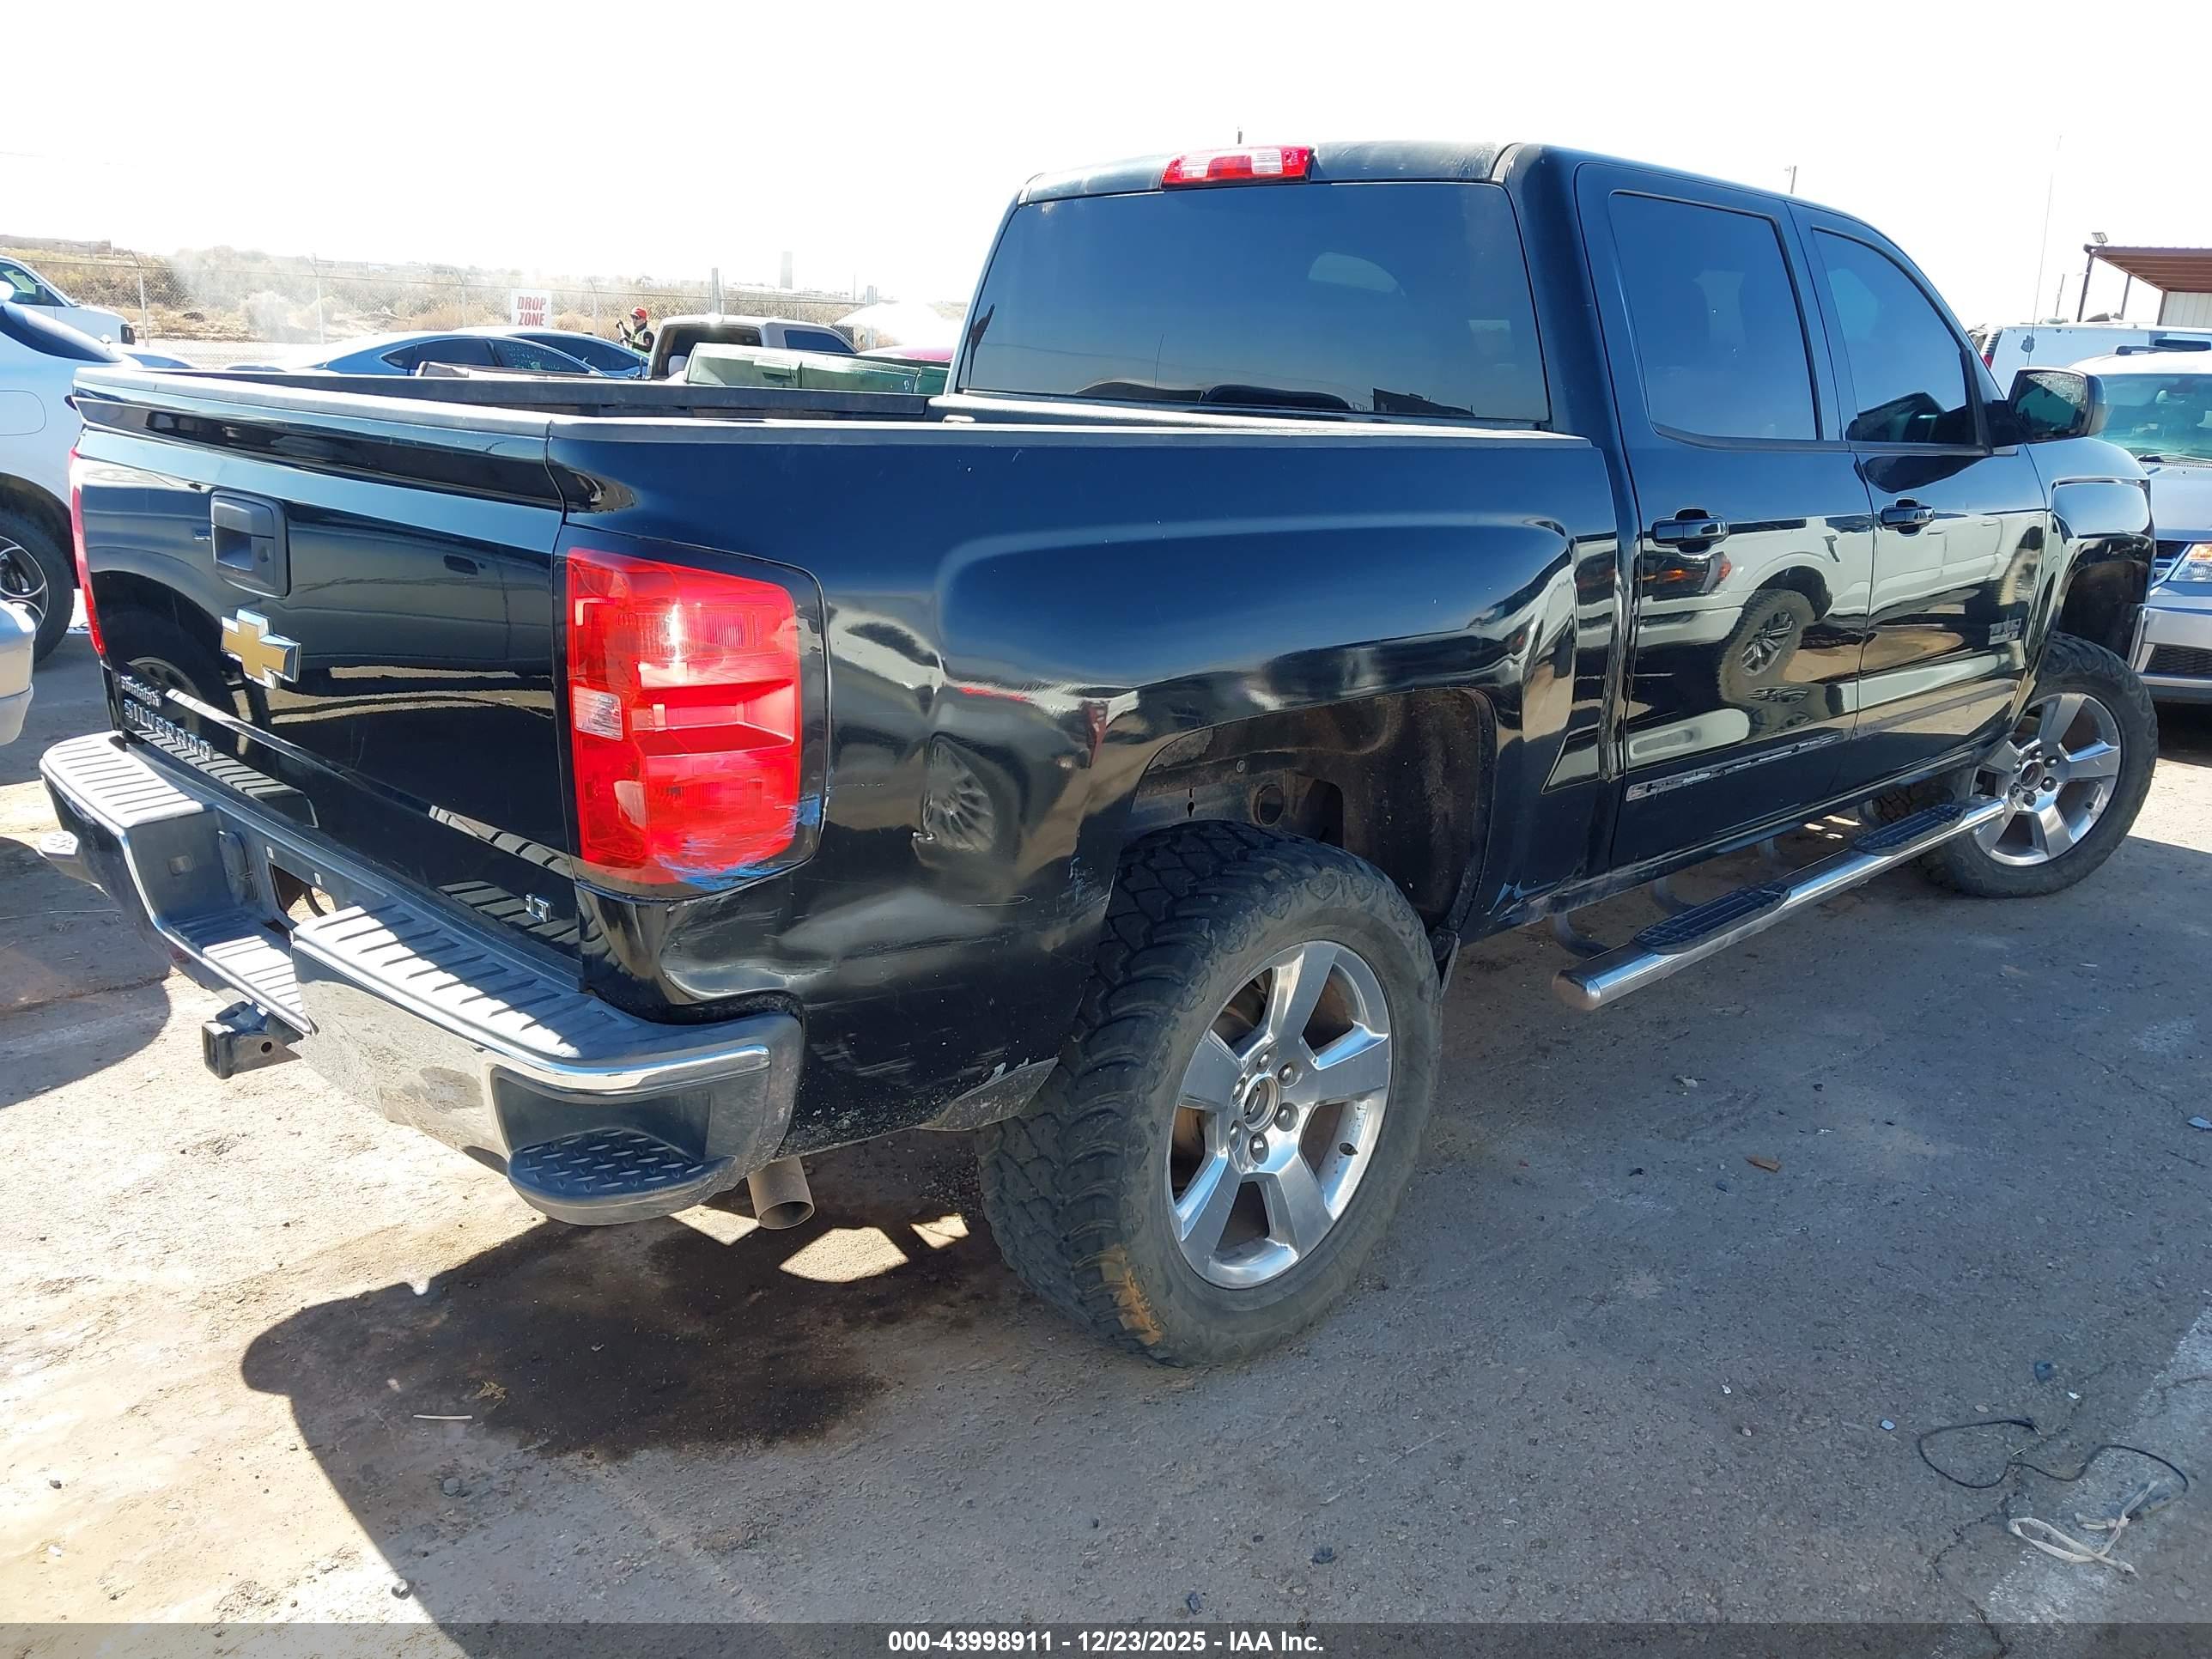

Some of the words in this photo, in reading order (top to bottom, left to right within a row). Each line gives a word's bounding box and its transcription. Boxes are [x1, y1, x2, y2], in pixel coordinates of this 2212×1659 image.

[517, 295, 547, 311] DROP
[517, 312, 545, 326] ZONE
[124, 698, 215, 763] SILVERADO
[526, 893, 553, 923] LT
